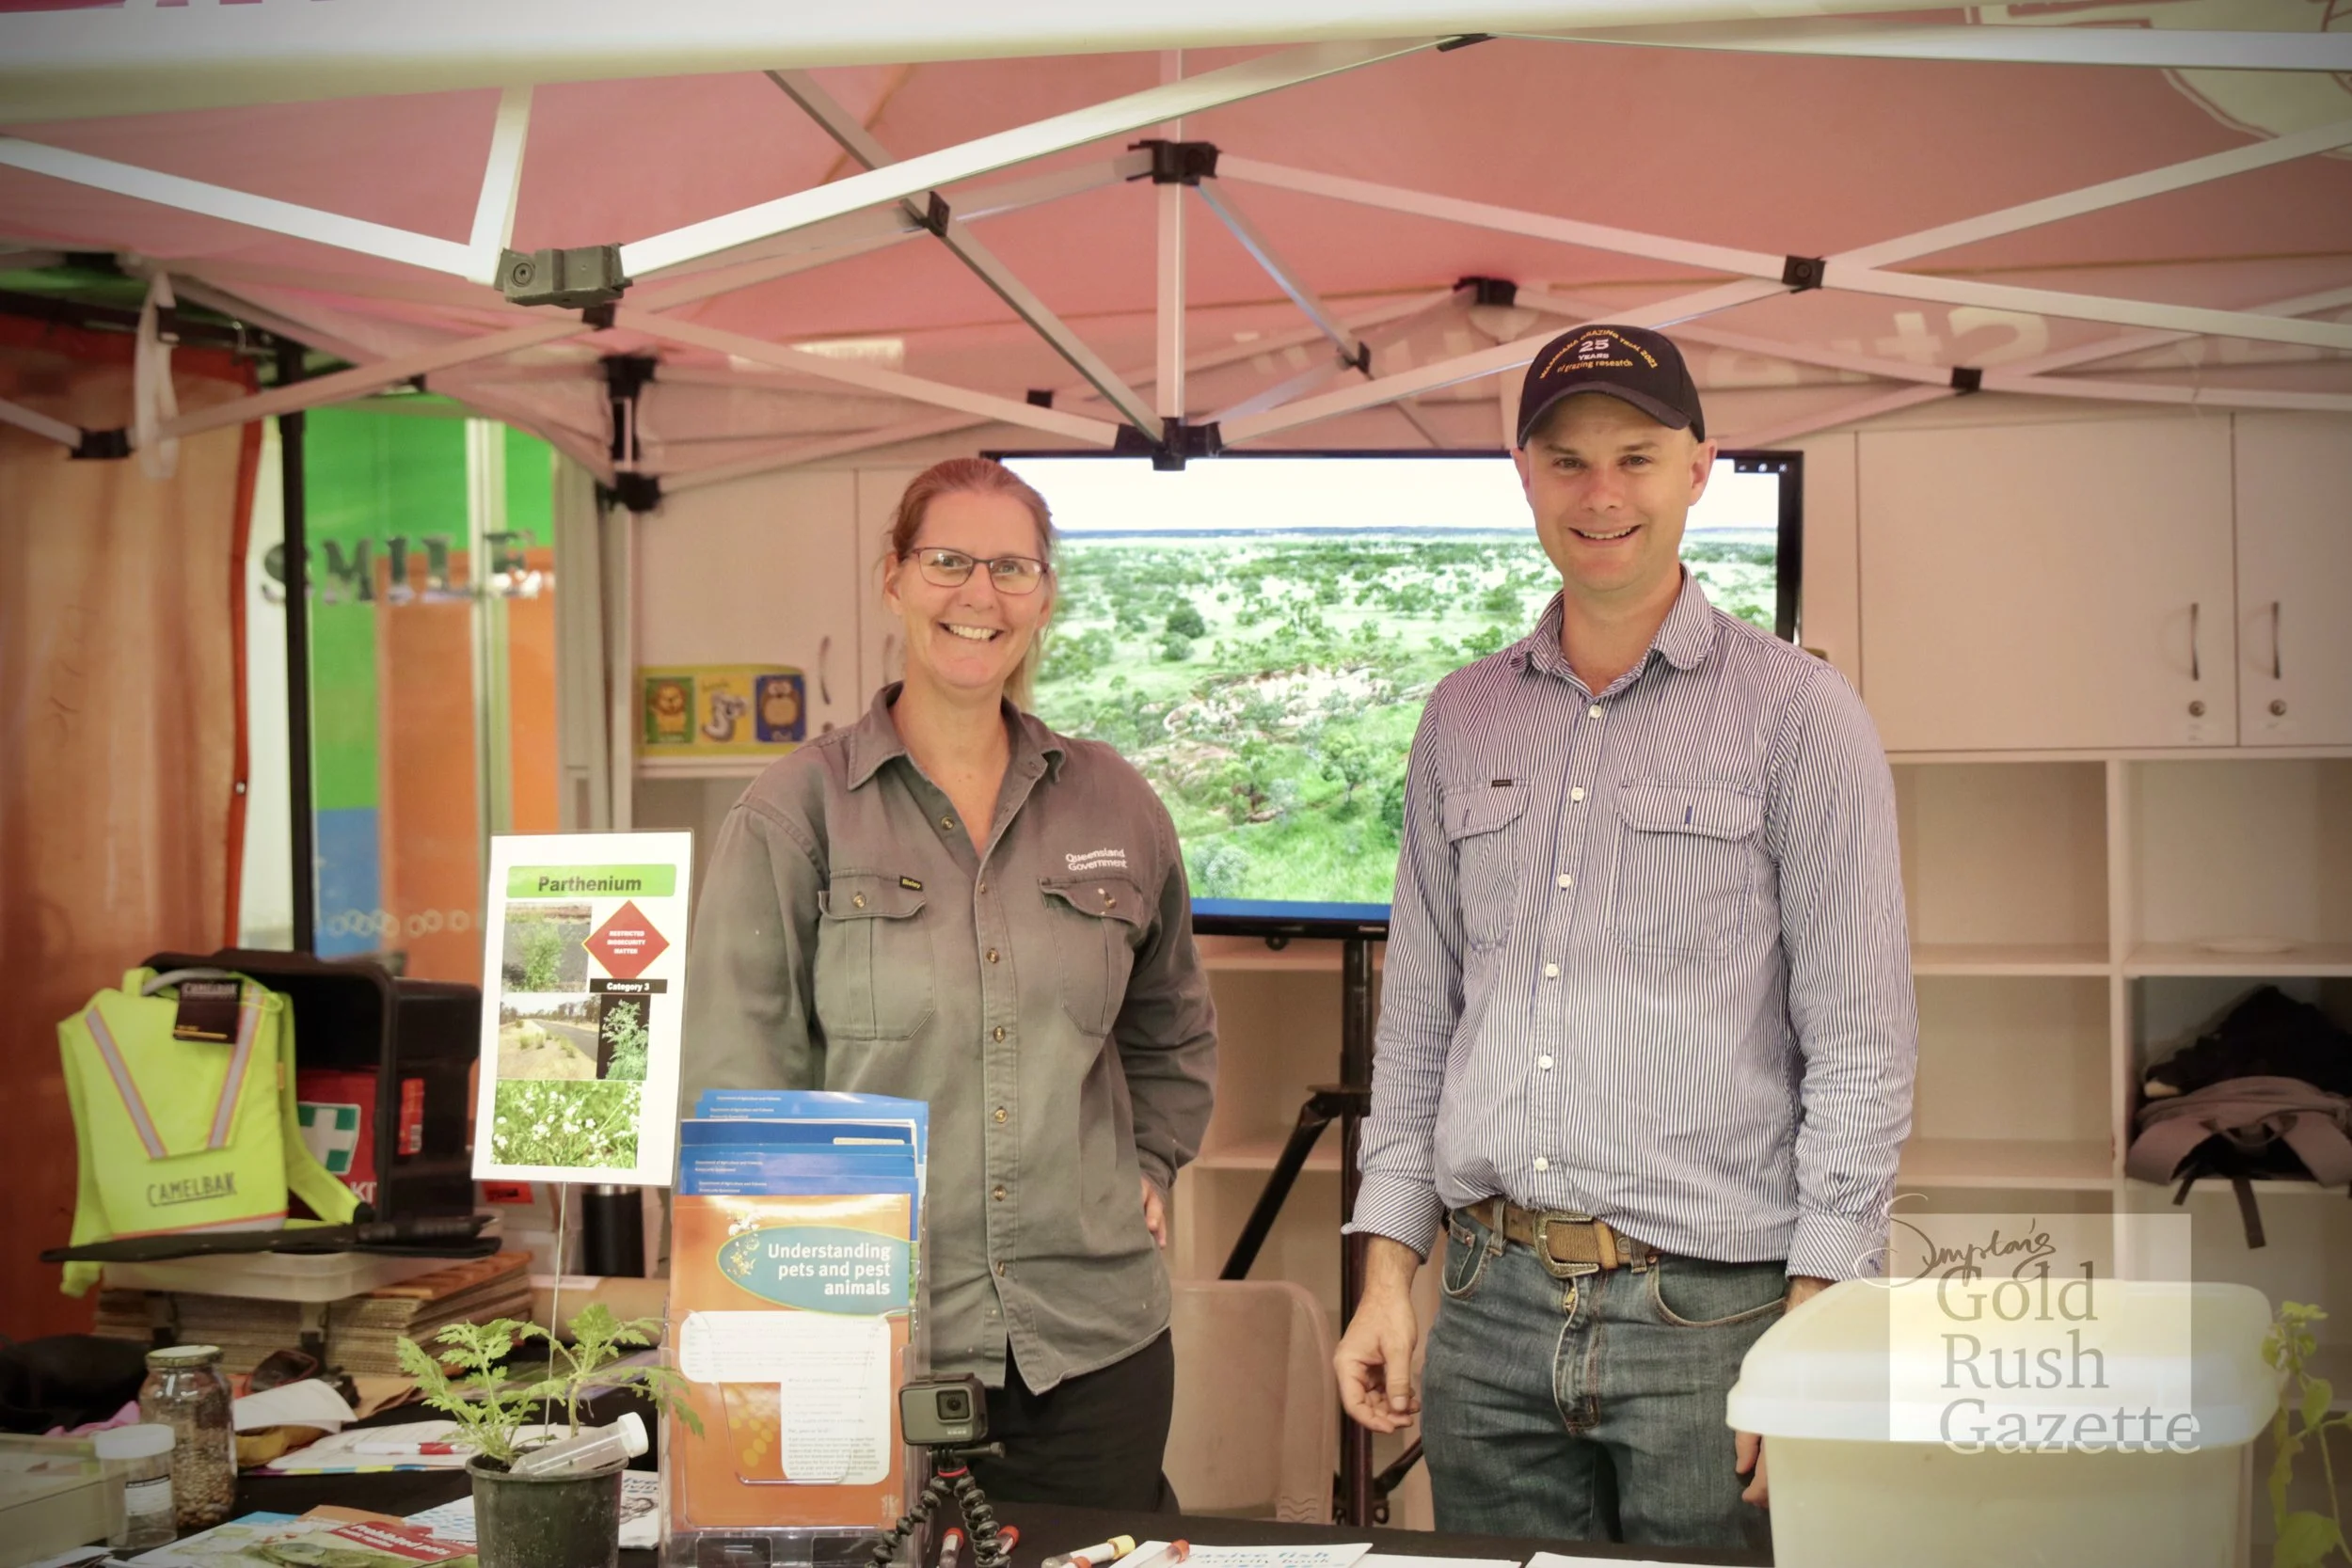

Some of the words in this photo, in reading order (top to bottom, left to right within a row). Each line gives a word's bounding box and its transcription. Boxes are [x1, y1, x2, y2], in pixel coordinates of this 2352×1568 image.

[1579, 339, 1609, 354] 25
[1581, 329, 1619, 341] GRAZING
[1619, 337, 1642, 353] TRIAL
[1578, 353, 1610, 361] YEARS
[1557, 363, 1565, 373] of
[1564, 360, 1595, 372] grazing
[1595, 358, 1633, 368] research
[1065, 847, 1126, 863] Queensland
[1068, 859, 1128, 871] Government
[538, 875, 642, 893] Parthenium
[606, 982, 643, 992] Category
[644, 982, 650, 991] 3
[147, 1171, 238, 1208] CAMELBAK
[768, 1243, 892, 1260] Understanding
[778, 1262, 815, 1280] pets
[818, 1261, 850, 1276] and
[854, 1262, 891, 1280] pest
[824, 1279, 891, 1295] animals
[417, 1543, 452, 1556] pets
